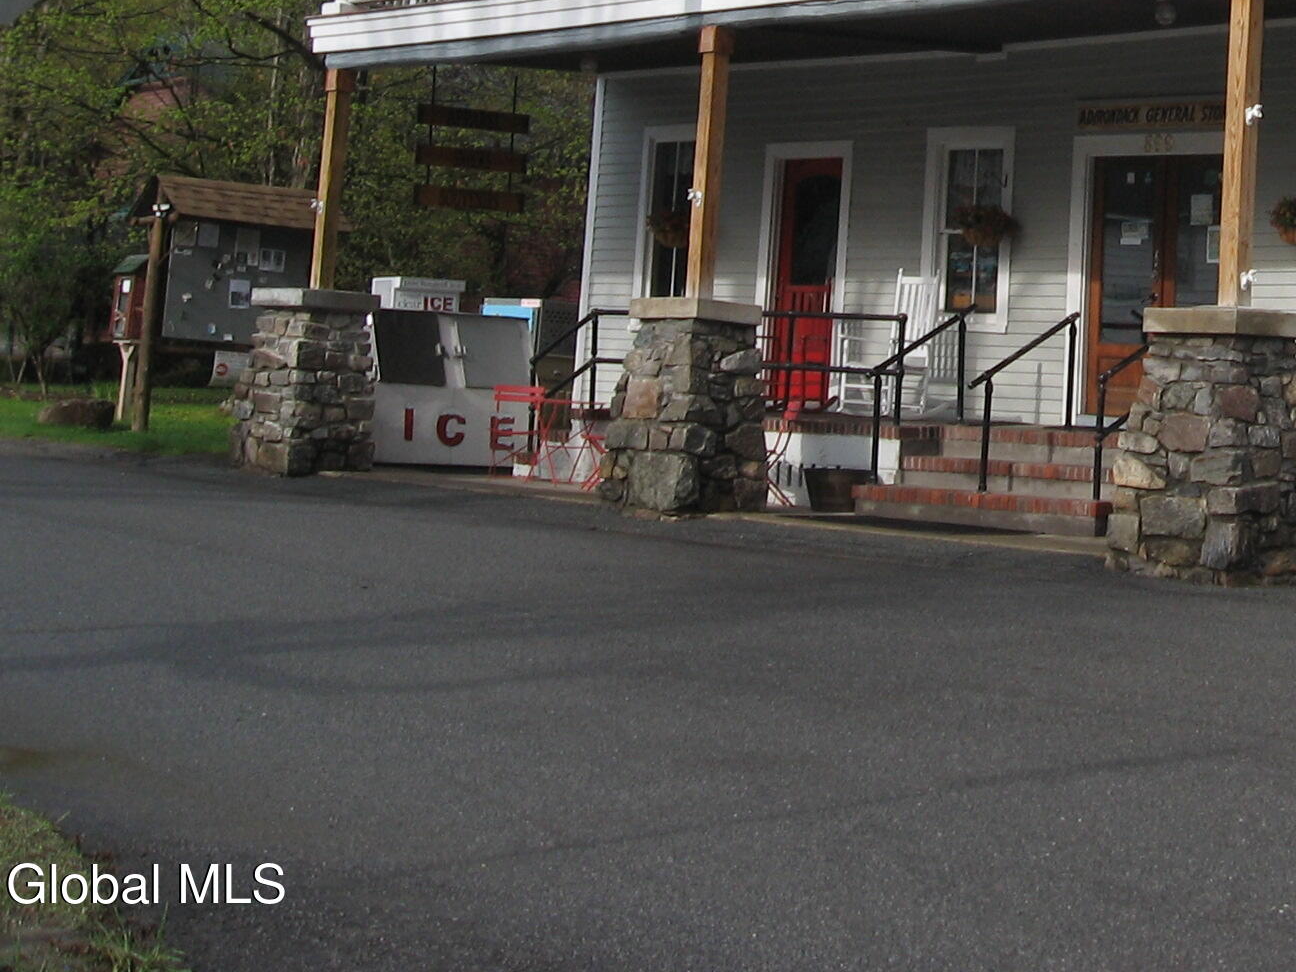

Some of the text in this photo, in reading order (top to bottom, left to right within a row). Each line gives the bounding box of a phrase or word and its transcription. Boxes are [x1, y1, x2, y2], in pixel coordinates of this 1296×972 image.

[1145, 105, 1196, 123] GENERAL
[424, 296, 454, 311] ICE
[404, 407, 515, 451] ICE
